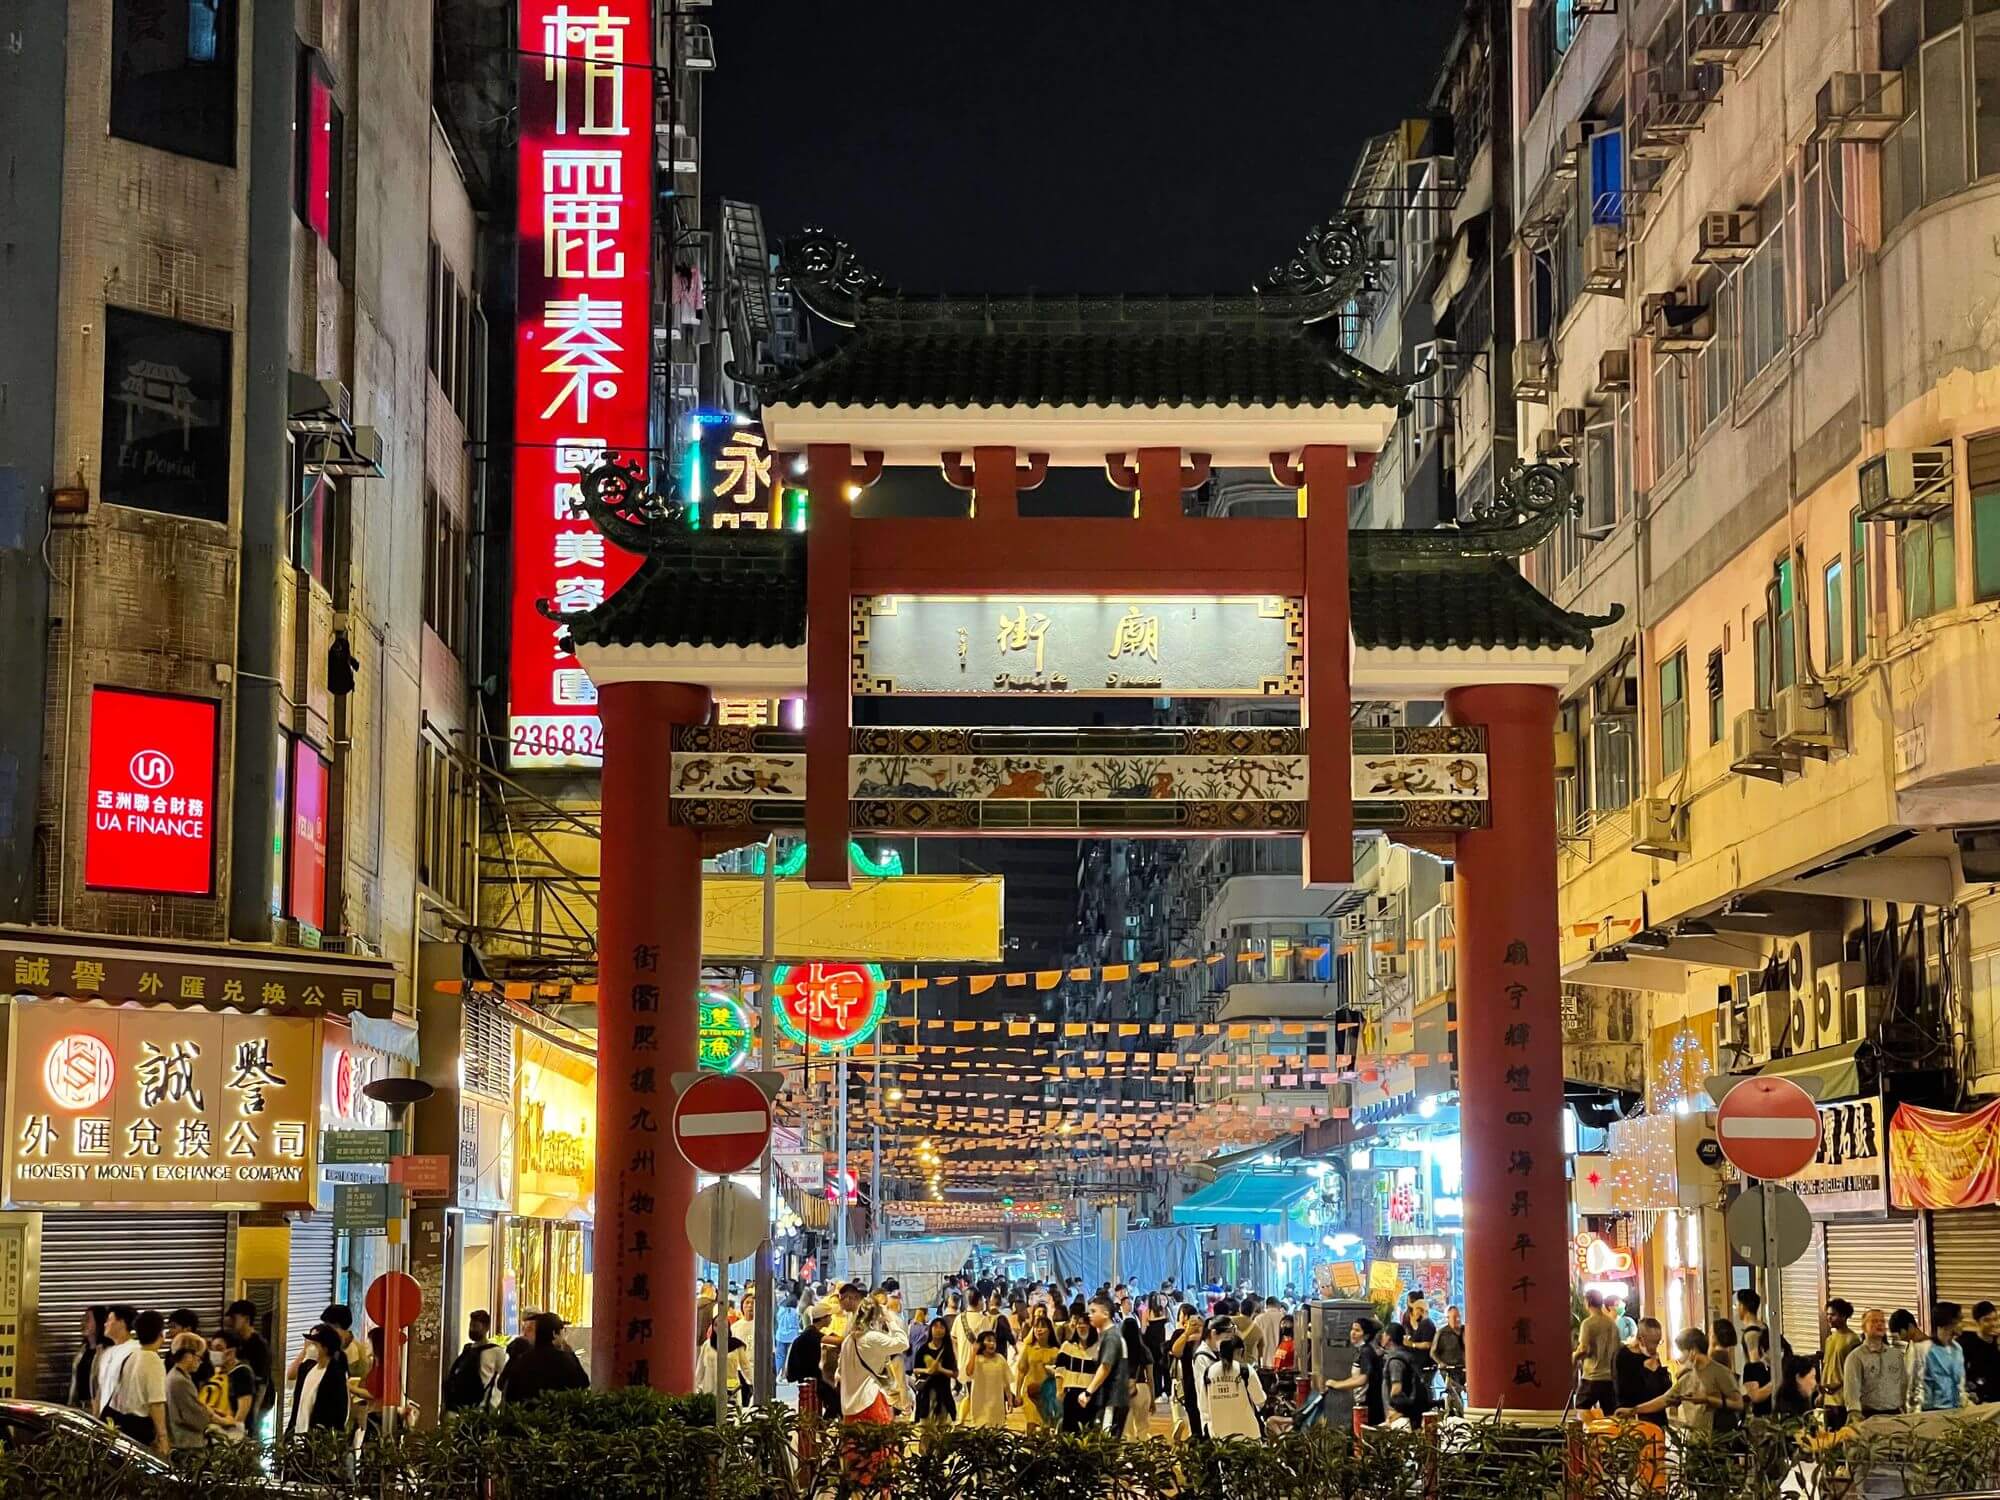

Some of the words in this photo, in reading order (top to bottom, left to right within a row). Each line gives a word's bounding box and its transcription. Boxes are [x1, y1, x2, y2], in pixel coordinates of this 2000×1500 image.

[96, 790, 204, 817] 亞洲聯合財務
[95, 812, 122, 832] UA
[126, 814, 203, 838] FINANCE
[135, 1037, 287, 1116] 誠譽
[1702, 1143, 1718, 1153] ADT
[17, 1164, 90, 1181] HONESTY
[96, 1164, 149, 1181] MONEY
[155, 1165, 233, 1181] EXCHANGE
[238, 1165, 304, 1182] COMPANY
[1853, 1175, 1873, 1191] WATCH
